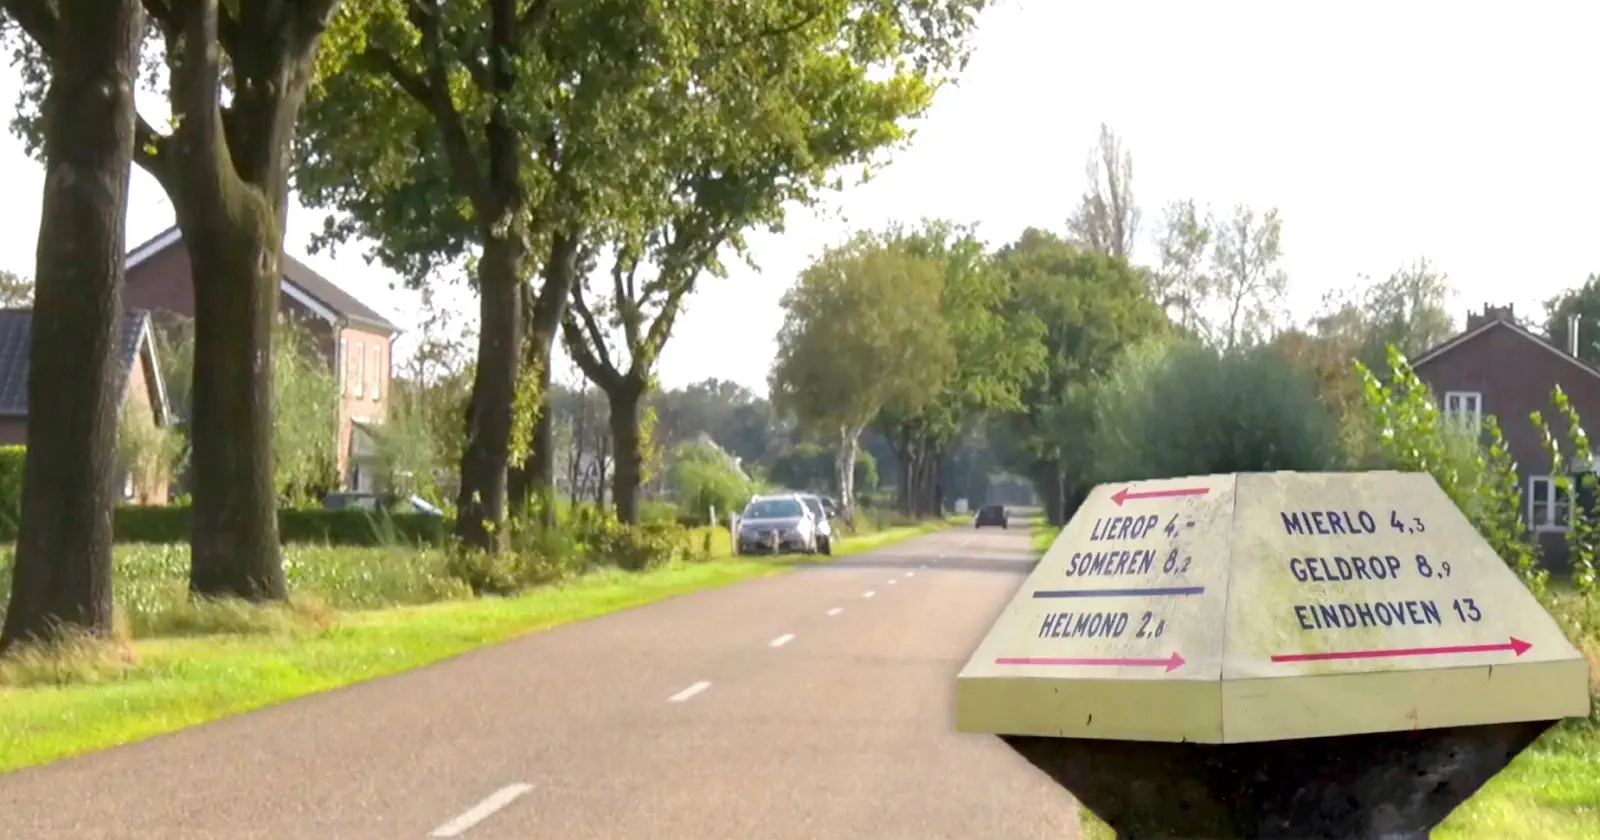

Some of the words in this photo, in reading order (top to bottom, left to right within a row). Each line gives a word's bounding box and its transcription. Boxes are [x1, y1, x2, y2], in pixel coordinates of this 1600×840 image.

[1089, 514, 1159, 541] LIEROP
[1280, 510, 1376, 535] MIERLO
[1390, 510, 1426, 533] 4,3
[1065, 549, 1156, 577] SOMEREN
[1162, 547, 1192, 576] 8,2
[1290, 555, 1401, 582] GELDROP
[1415, 554, 1451, 579] 8,9
[1038, 612, 1129, 639] HELMOND
[1294, 600, 1442, 630] EINDHOVEN
[1453, 598, 1482, 623] 13
